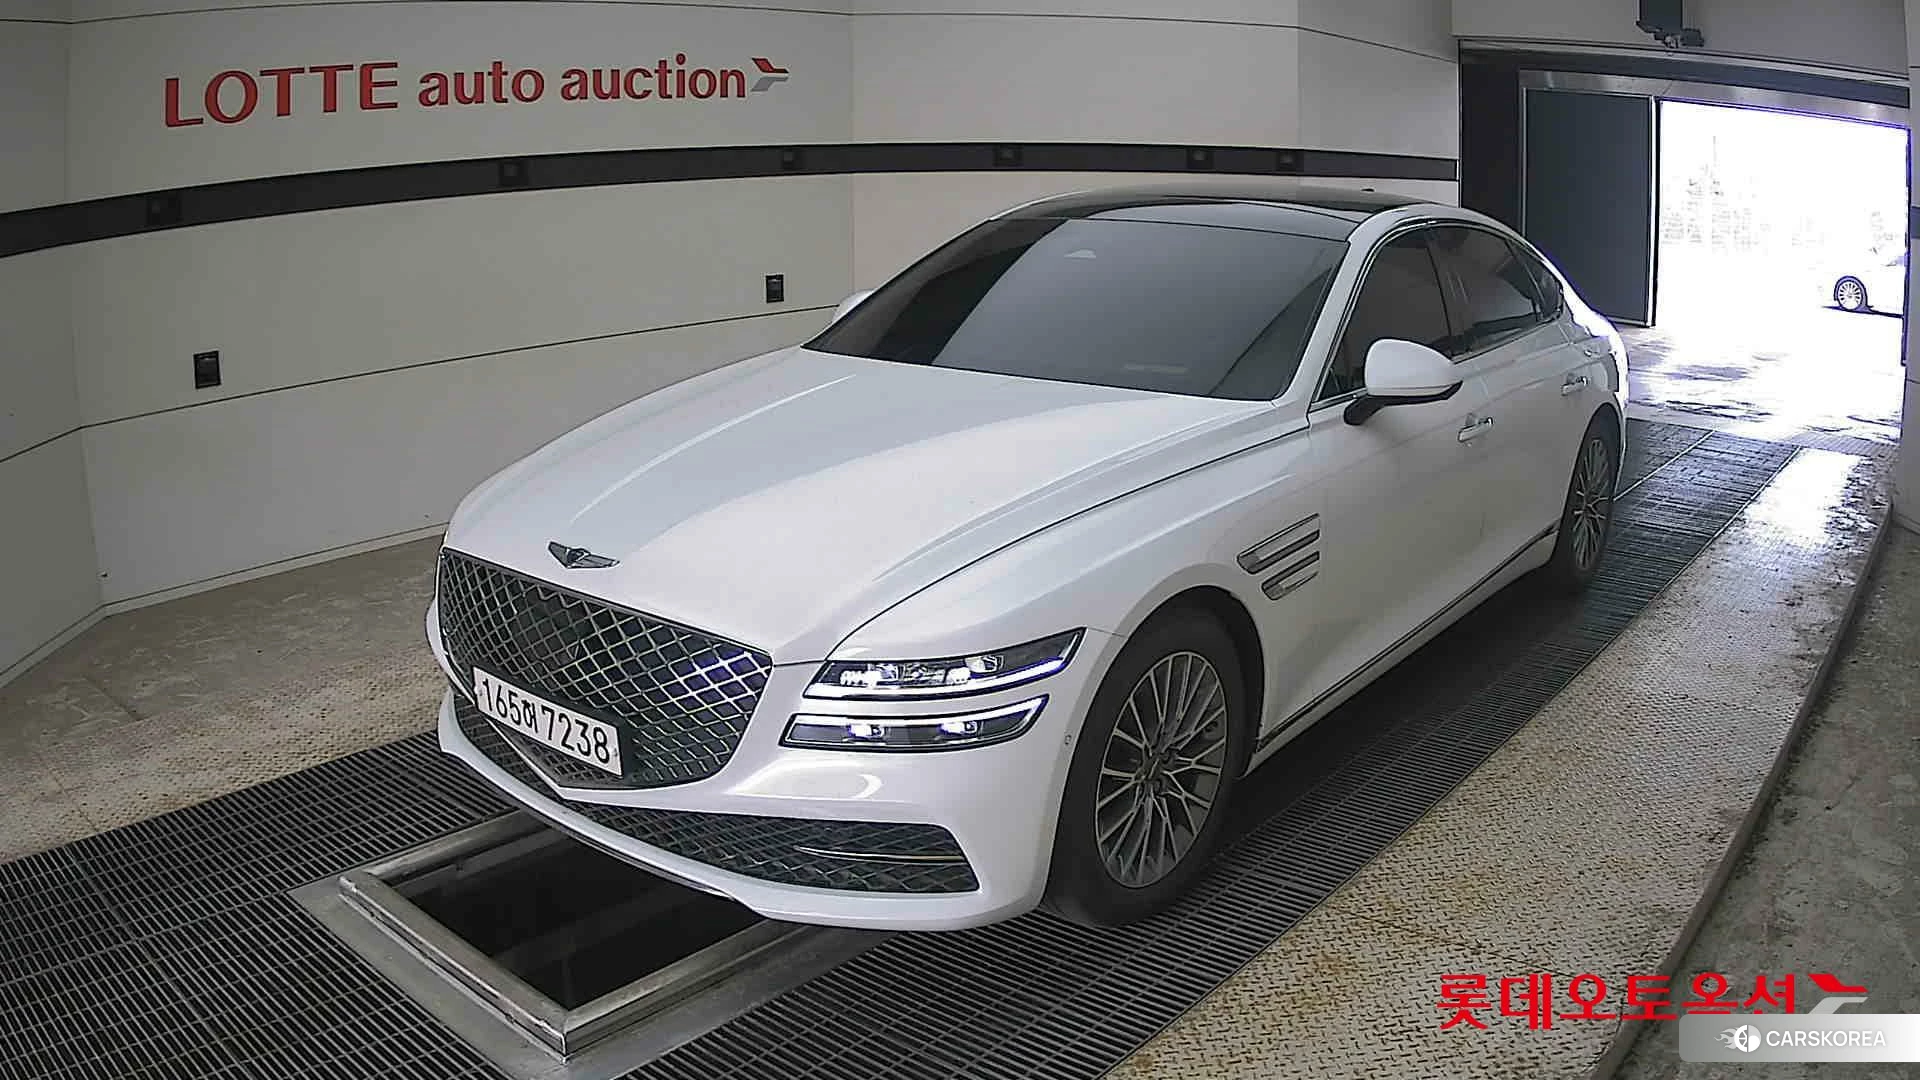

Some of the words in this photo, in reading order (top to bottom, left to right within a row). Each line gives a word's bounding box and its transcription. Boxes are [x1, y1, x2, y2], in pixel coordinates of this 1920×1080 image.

[165, 63, 398, 128] LOTTE
[418, 61, 545, 107] auto
[560, 53, 746, 101] auction
